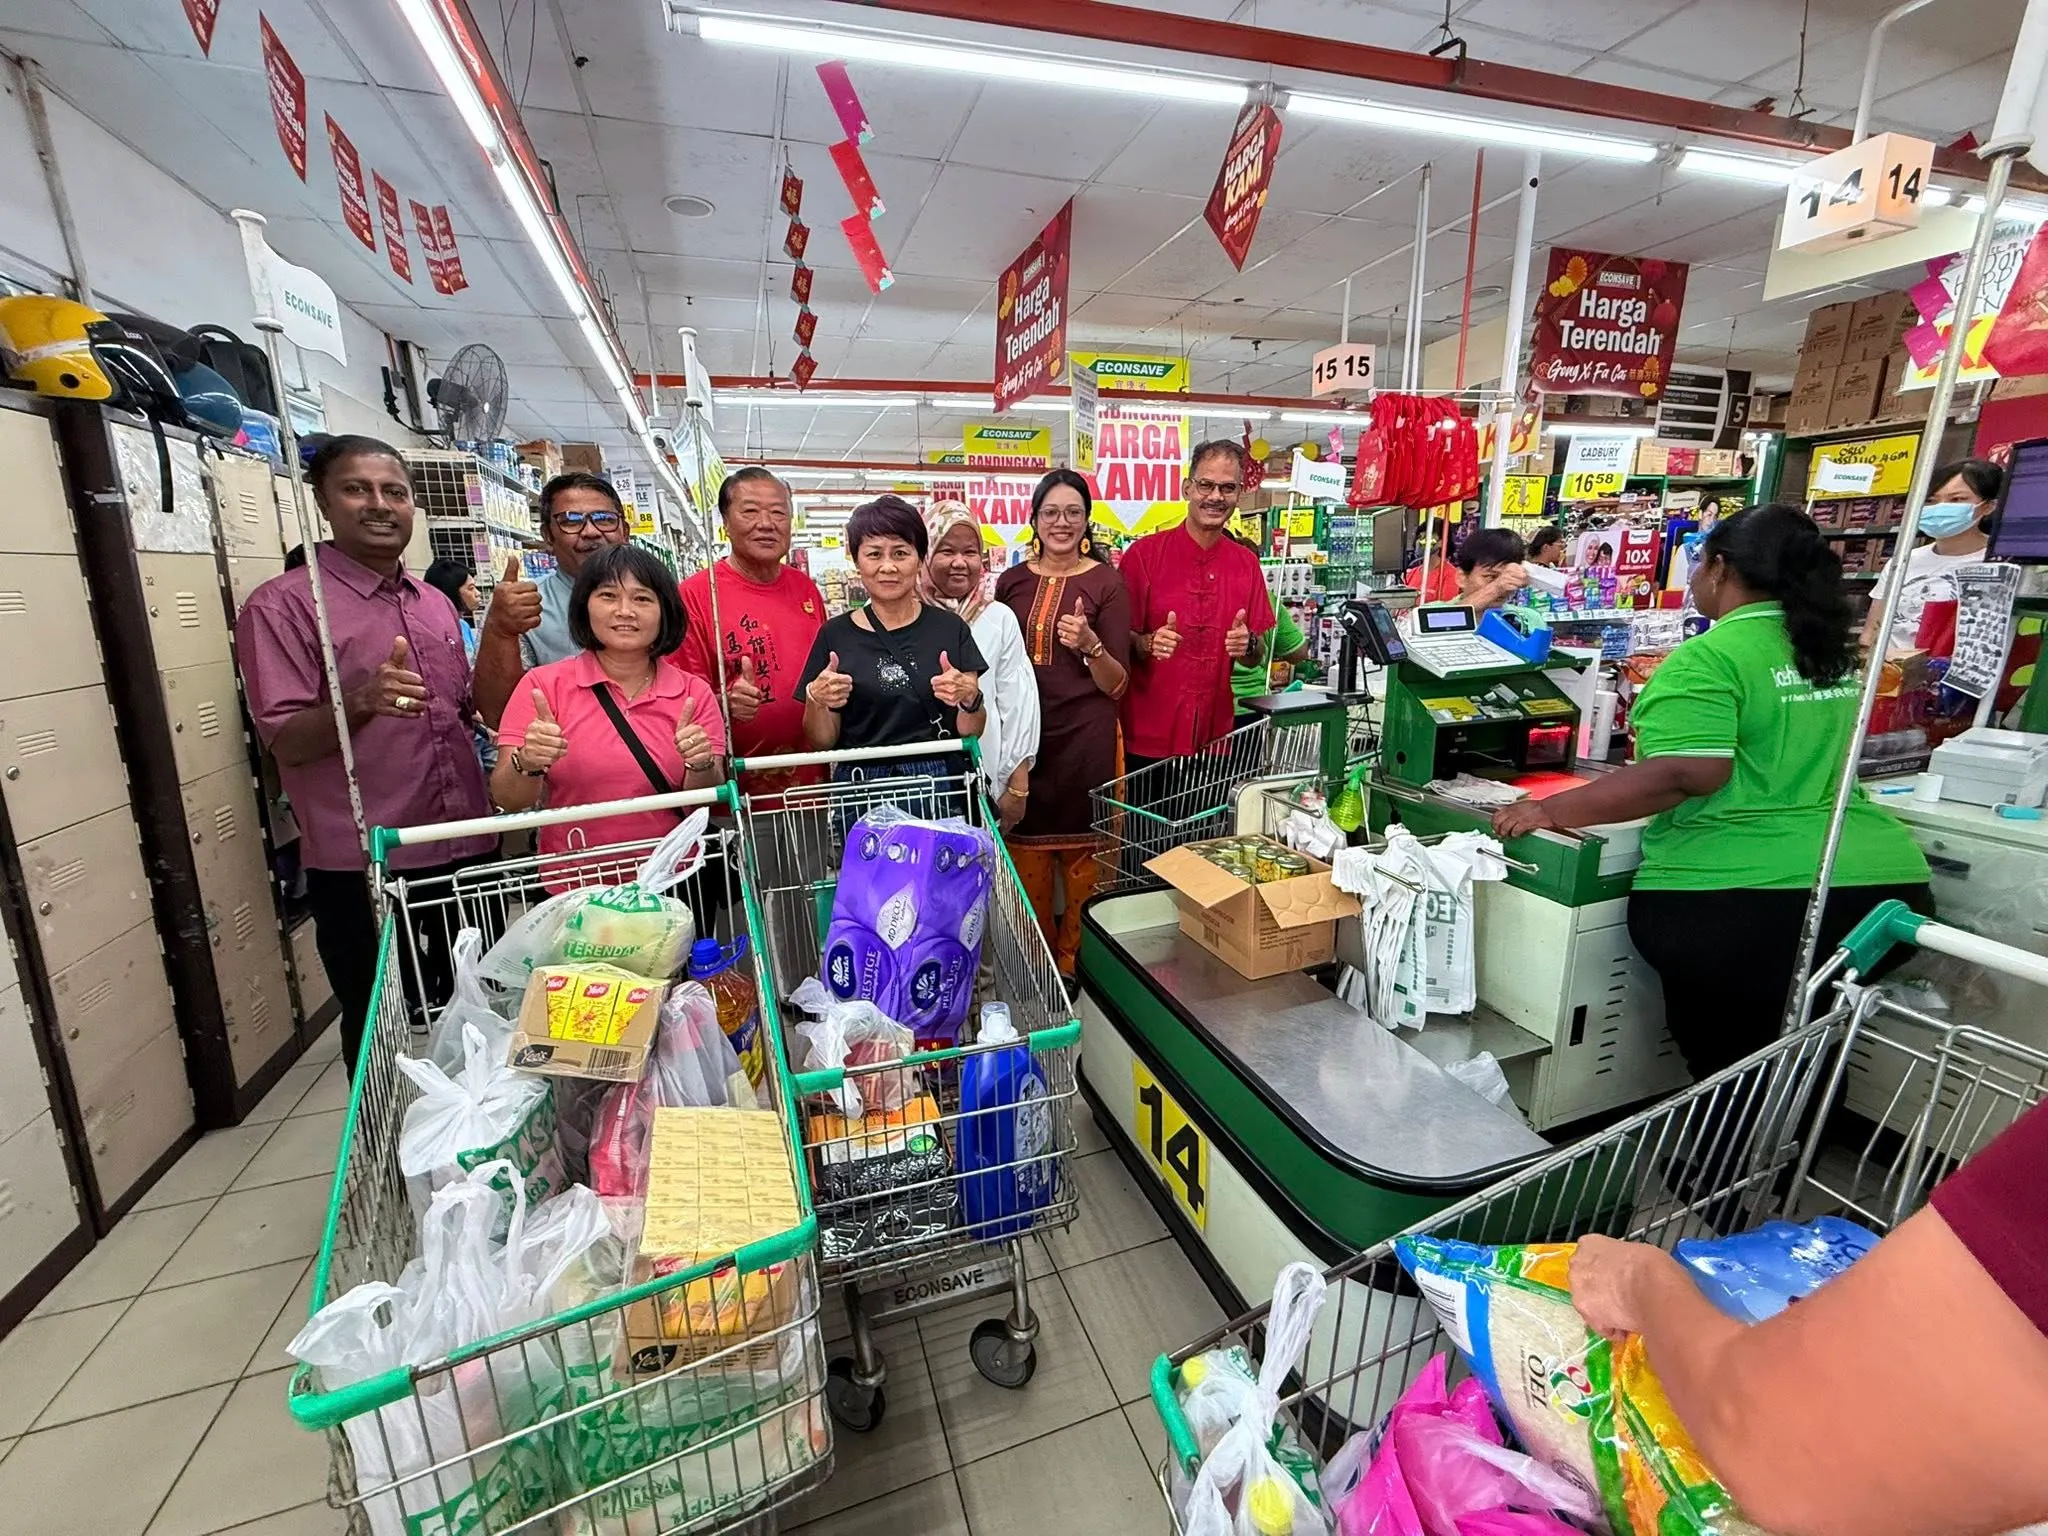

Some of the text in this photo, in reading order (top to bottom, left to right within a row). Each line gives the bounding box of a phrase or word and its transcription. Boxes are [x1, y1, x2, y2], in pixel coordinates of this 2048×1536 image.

[1224, 125, 1265, 188] HARGA
[1224, 148, 1264, 215] KAMI
[1799, 168, 1864, 219] 14
[1888, 163, 1922, 203] 14
[1600, 272, 1635, 284] ECONSAVE
[285, 290, 332, 328] ECONSAVE
[1014, 276, 1050, 327] Harga
[1579, 288, 1647, 327] Harga
[1005, 299, 1060, 364] Terendah
[1560, 320, 1660, 355] Terendah
[1096, 361, 1164, 375] ECONSAVE
[1315, 359, 1337, 383] 15
[1344, 355, 1370, 377] 15
[1547, 359, 1580, 382] Gong
[1592, 362, 1610, 383] Fa
[1733, 402, 1745, 423] 5
[983, 430, 1032, 439] ECONSAVE
[1097, 423, 1182, 460] ARGA
[1581, 448, 1620, 457] CADBURY
[1310, 474, 1341, 486] ECONSAVE
[1575, 473, 1614, 492] 16 58
[1625, 549, 1652, 563] 10X
[861, 950, 877, 1000] RESTIGE
[927, 970, 936, 1000] Vinda
[1140, 1083, 1204, 1215] 14
[894, 1270, 985, 1304] ECONSAVE
